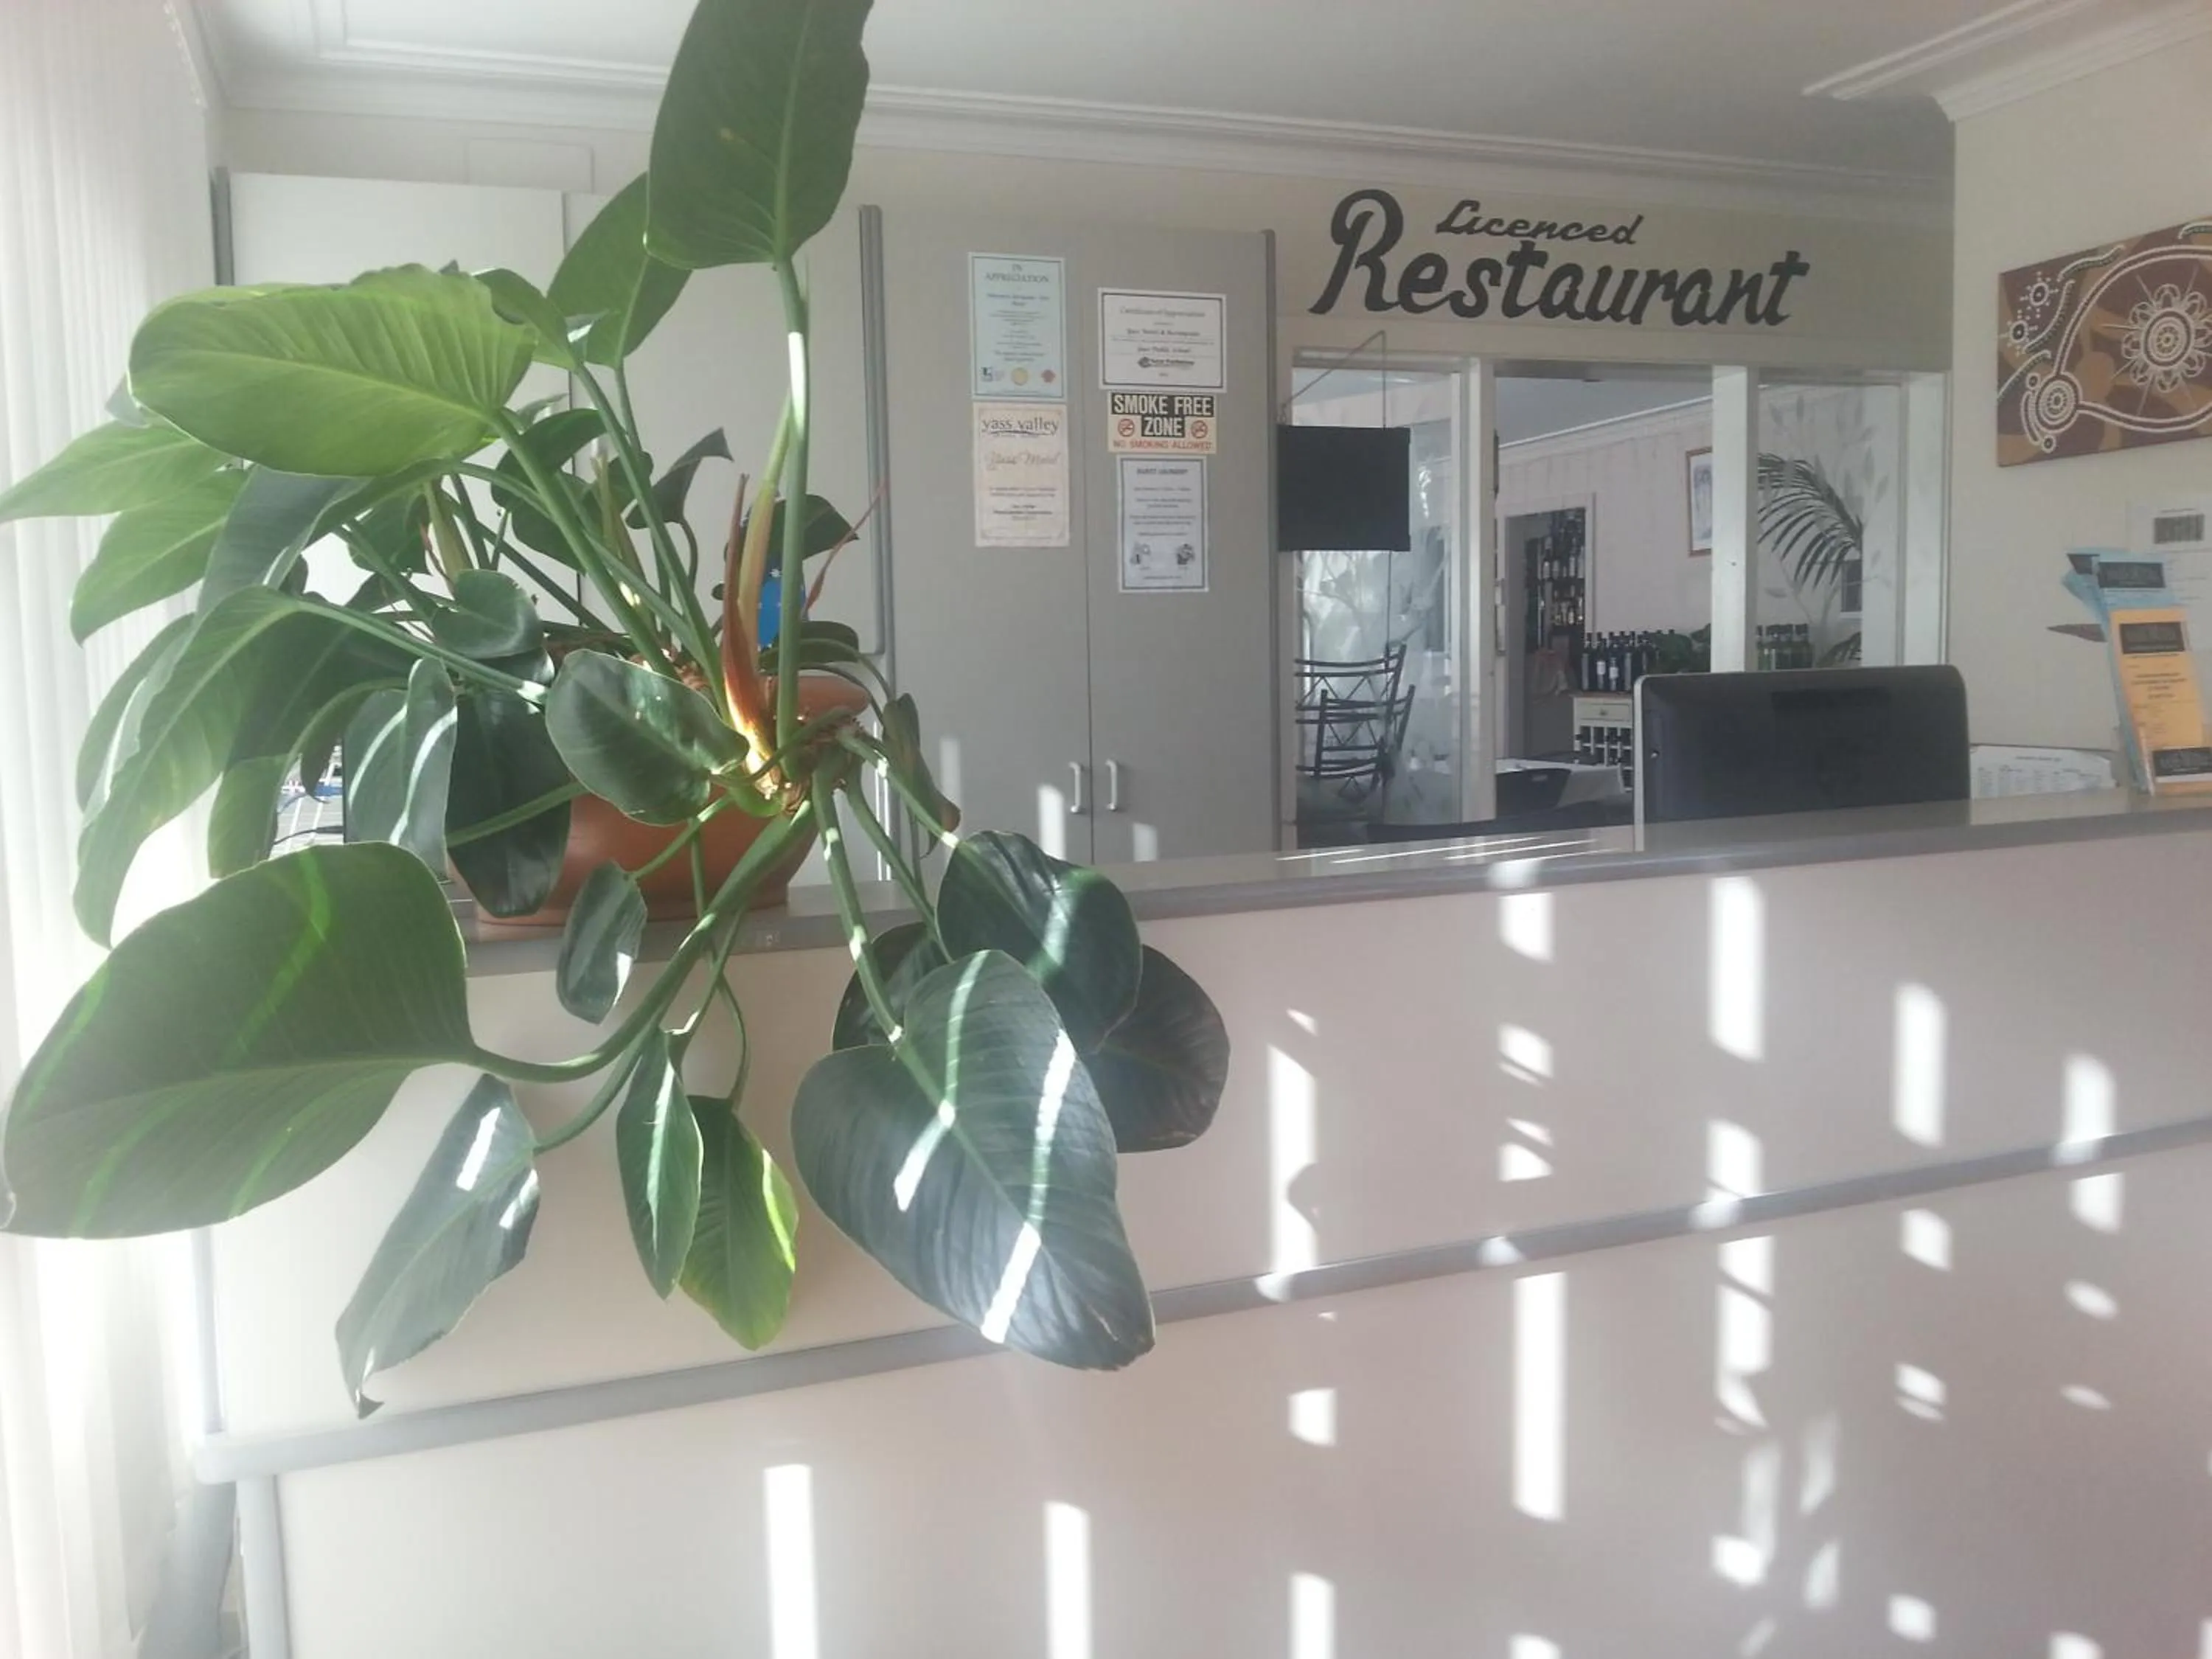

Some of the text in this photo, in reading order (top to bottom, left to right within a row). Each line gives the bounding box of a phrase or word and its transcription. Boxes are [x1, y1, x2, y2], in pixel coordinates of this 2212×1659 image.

[1435, 200, 1644, 244] Licenced
[1307, 189, 1810, 327] Restaurant
[1113, 394, 1211, 416] SMOKE FREE
[1144, 417, 1183, 437] ZONE
[1130, 440, 1169, 448] SMOKING
[1172, 441, 1213, 450] ALLOWED
